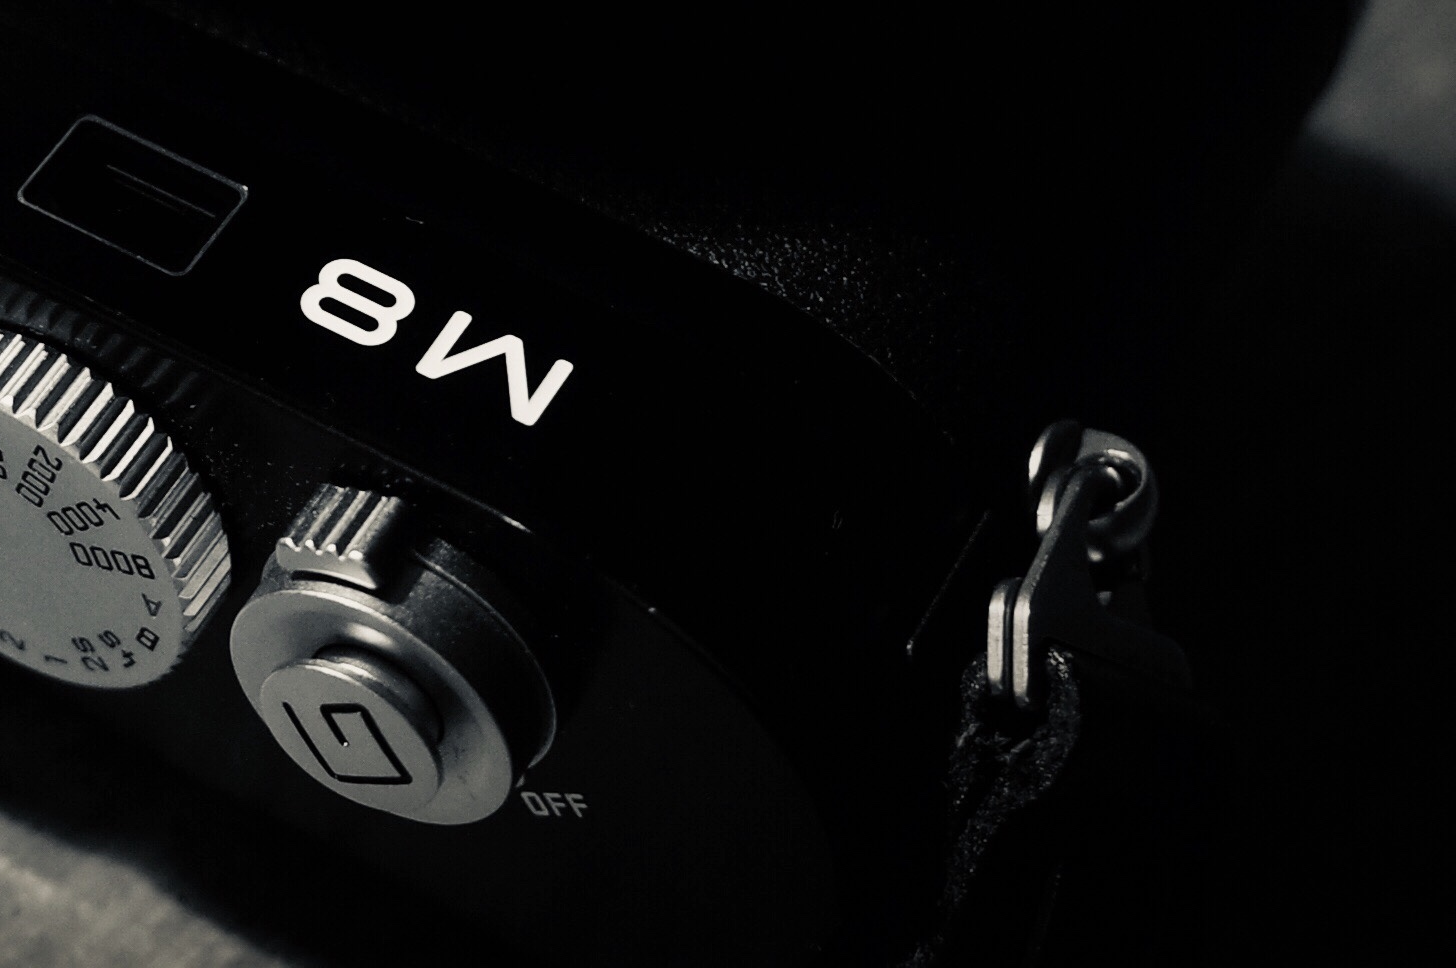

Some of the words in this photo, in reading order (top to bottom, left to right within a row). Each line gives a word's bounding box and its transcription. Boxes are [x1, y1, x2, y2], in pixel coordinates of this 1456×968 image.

[300, 258, 574, 427] M8
[15, 444, 63, 508] 2000
[47, 497, 121, 536] 4000
[69, 542, 155, 580] 8000
[142, 593, 163, 617] A
[135, 627, 160, 652] B
[521, 791, 588, 818] OFF
